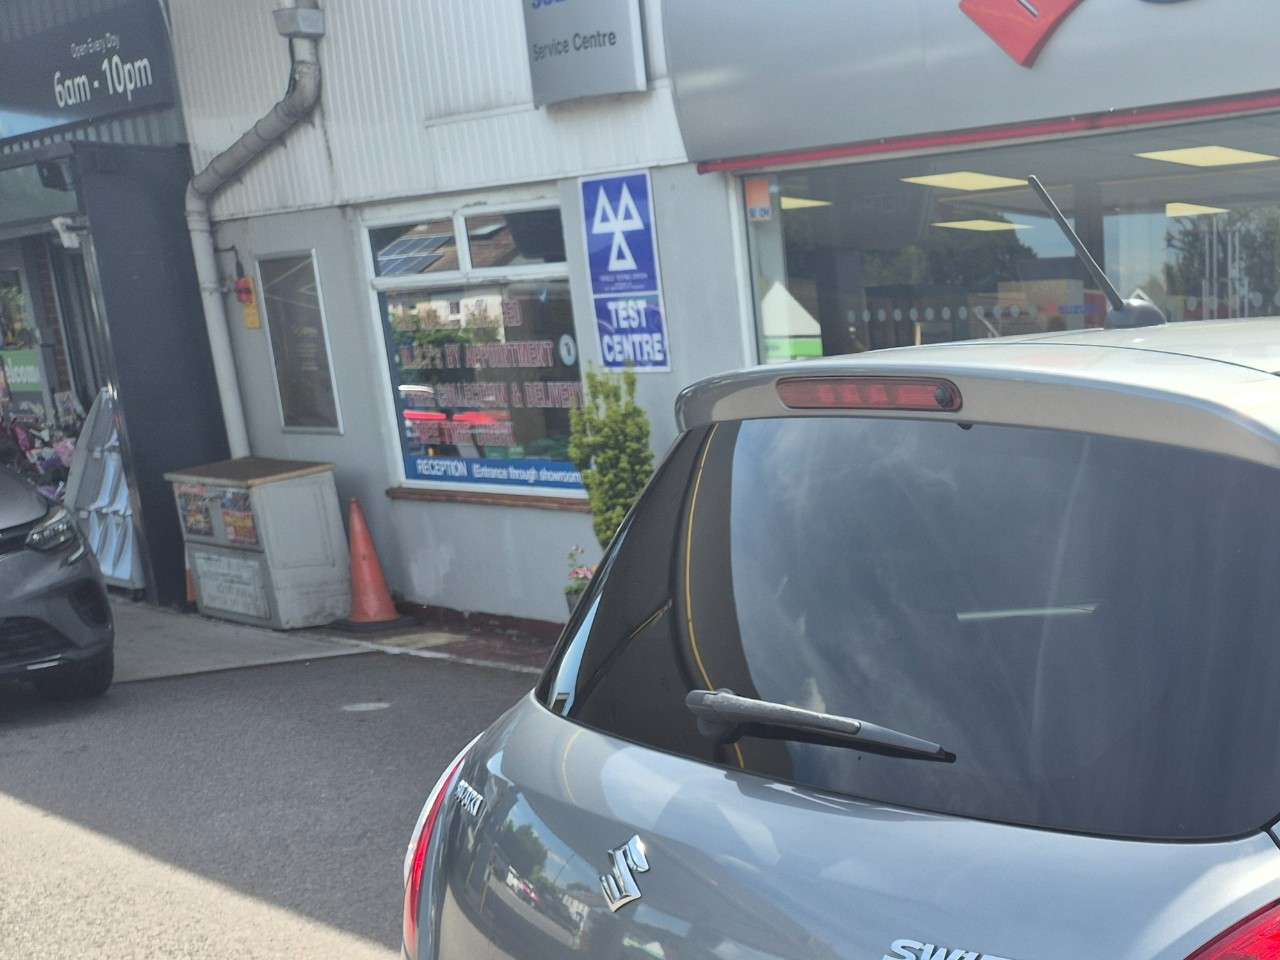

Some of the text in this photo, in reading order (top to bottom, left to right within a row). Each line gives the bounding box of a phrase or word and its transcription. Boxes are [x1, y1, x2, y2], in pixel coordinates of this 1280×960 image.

[532, 31, 616, 60] Service Centre
[54, 70, 91, 108] 6am
[102, 54, 153, 102] 10pm
[606, 299, 647, 329] TEST
[602, 332, 664, 362] CENTRE
[416, 459, 467, 477] RECEPTION
